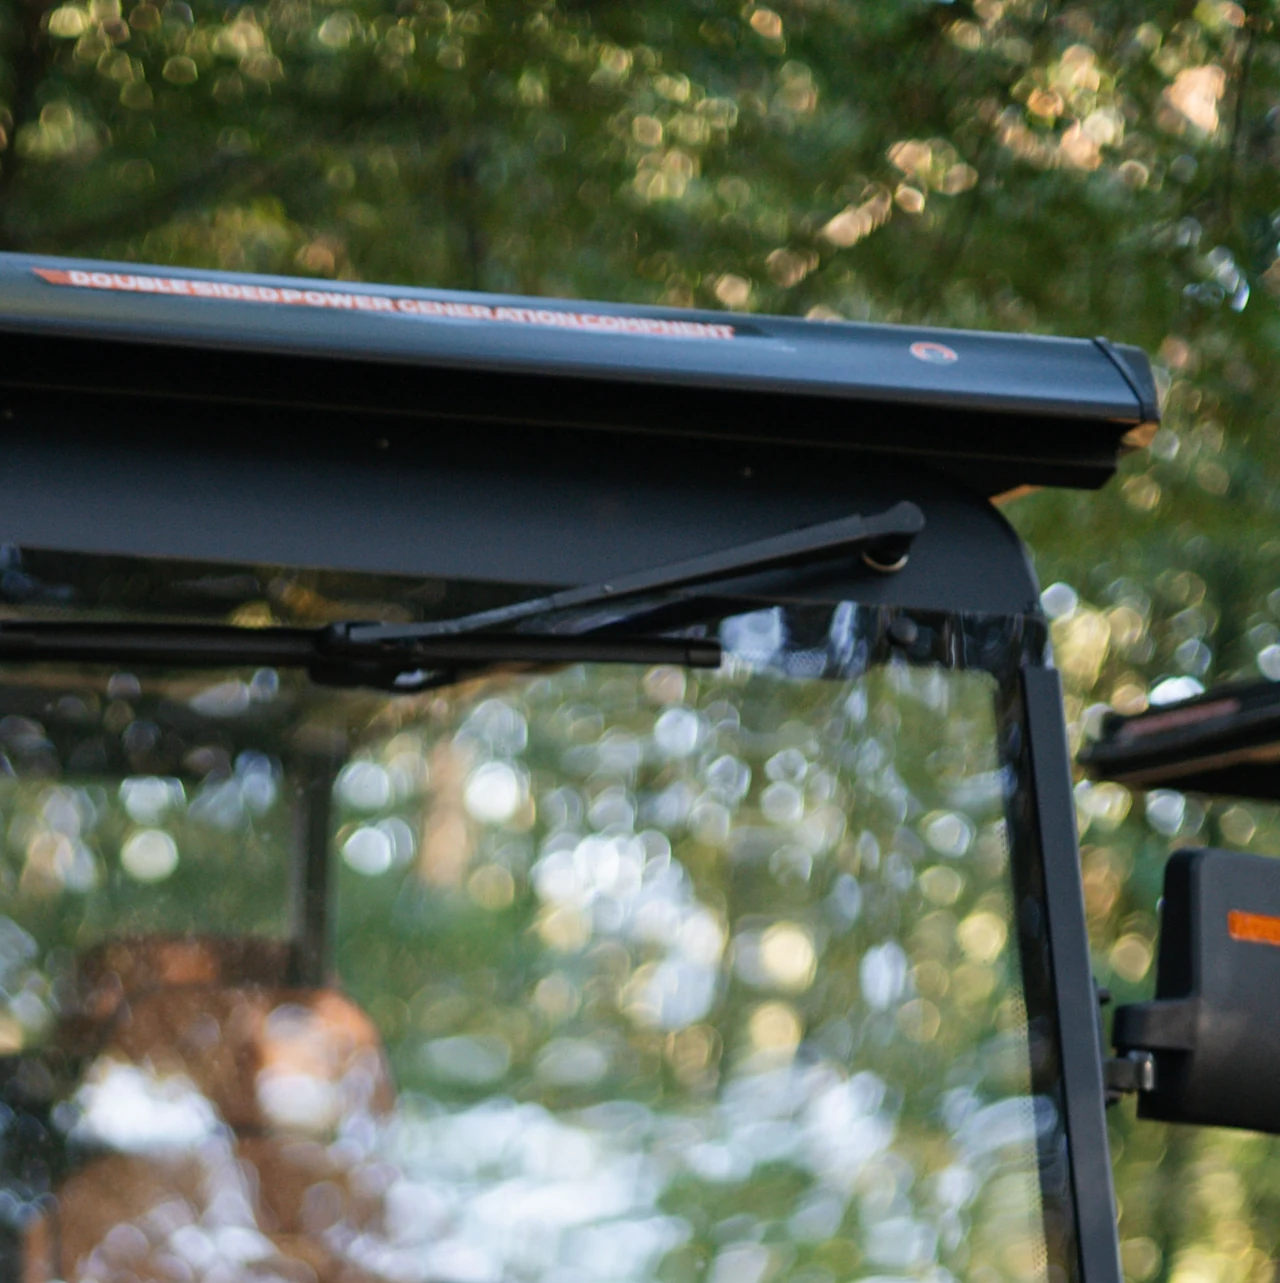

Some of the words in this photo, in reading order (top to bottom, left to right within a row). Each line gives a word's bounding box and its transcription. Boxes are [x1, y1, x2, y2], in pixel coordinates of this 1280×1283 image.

[68, 270, 189, 294] DOUBLE
[190, 280, 278, 302] SIDED
[280, 287, 394, 311] POWER
[397, 298, 579, 327] GENERATION
